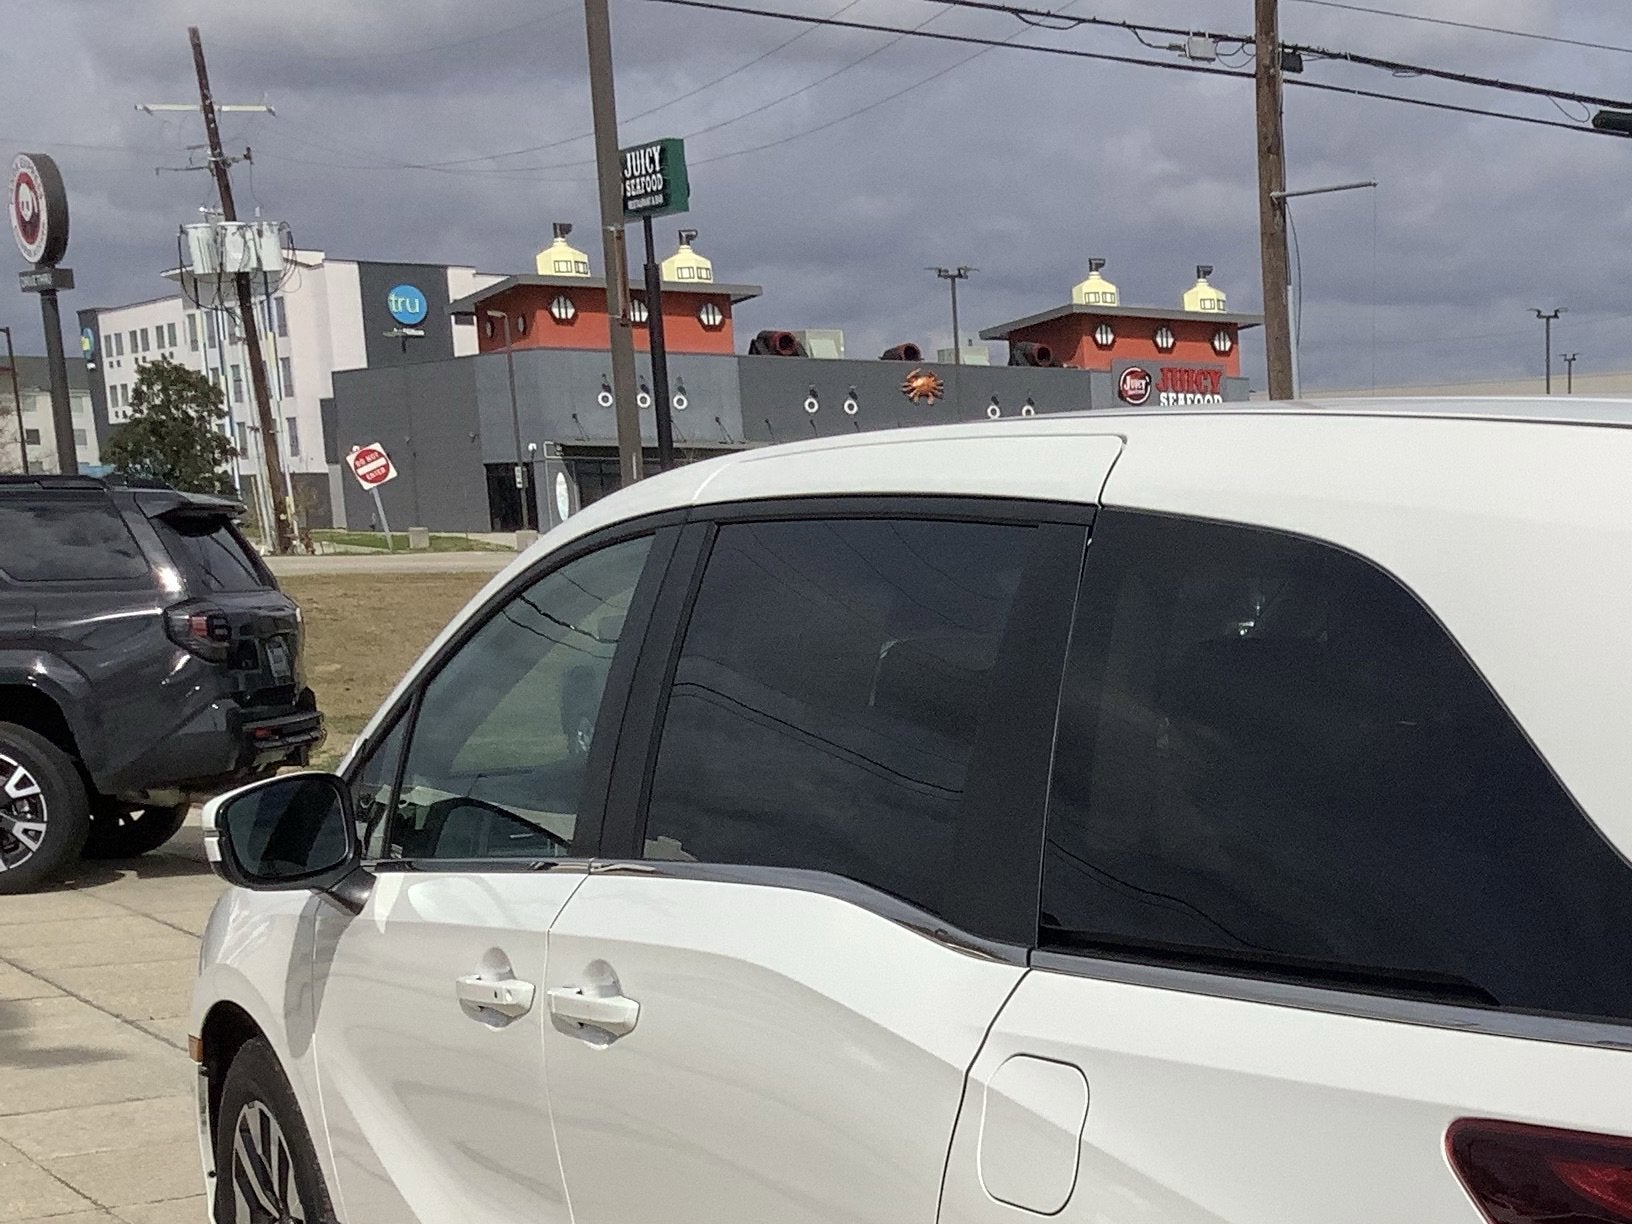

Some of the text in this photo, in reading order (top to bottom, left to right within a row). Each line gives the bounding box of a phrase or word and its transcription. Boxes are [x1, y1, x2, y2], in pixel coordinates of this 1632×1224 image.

[624, 145, 661, 178] JUICY
[625, 173, 663, 197] SEAFOOD
[389, 293, 420, 313] tru
[1155, 367, 1222, 394] JUICY
[365, 451, 379, 462] NOT
[365, 466, 386, 480] ENTER
